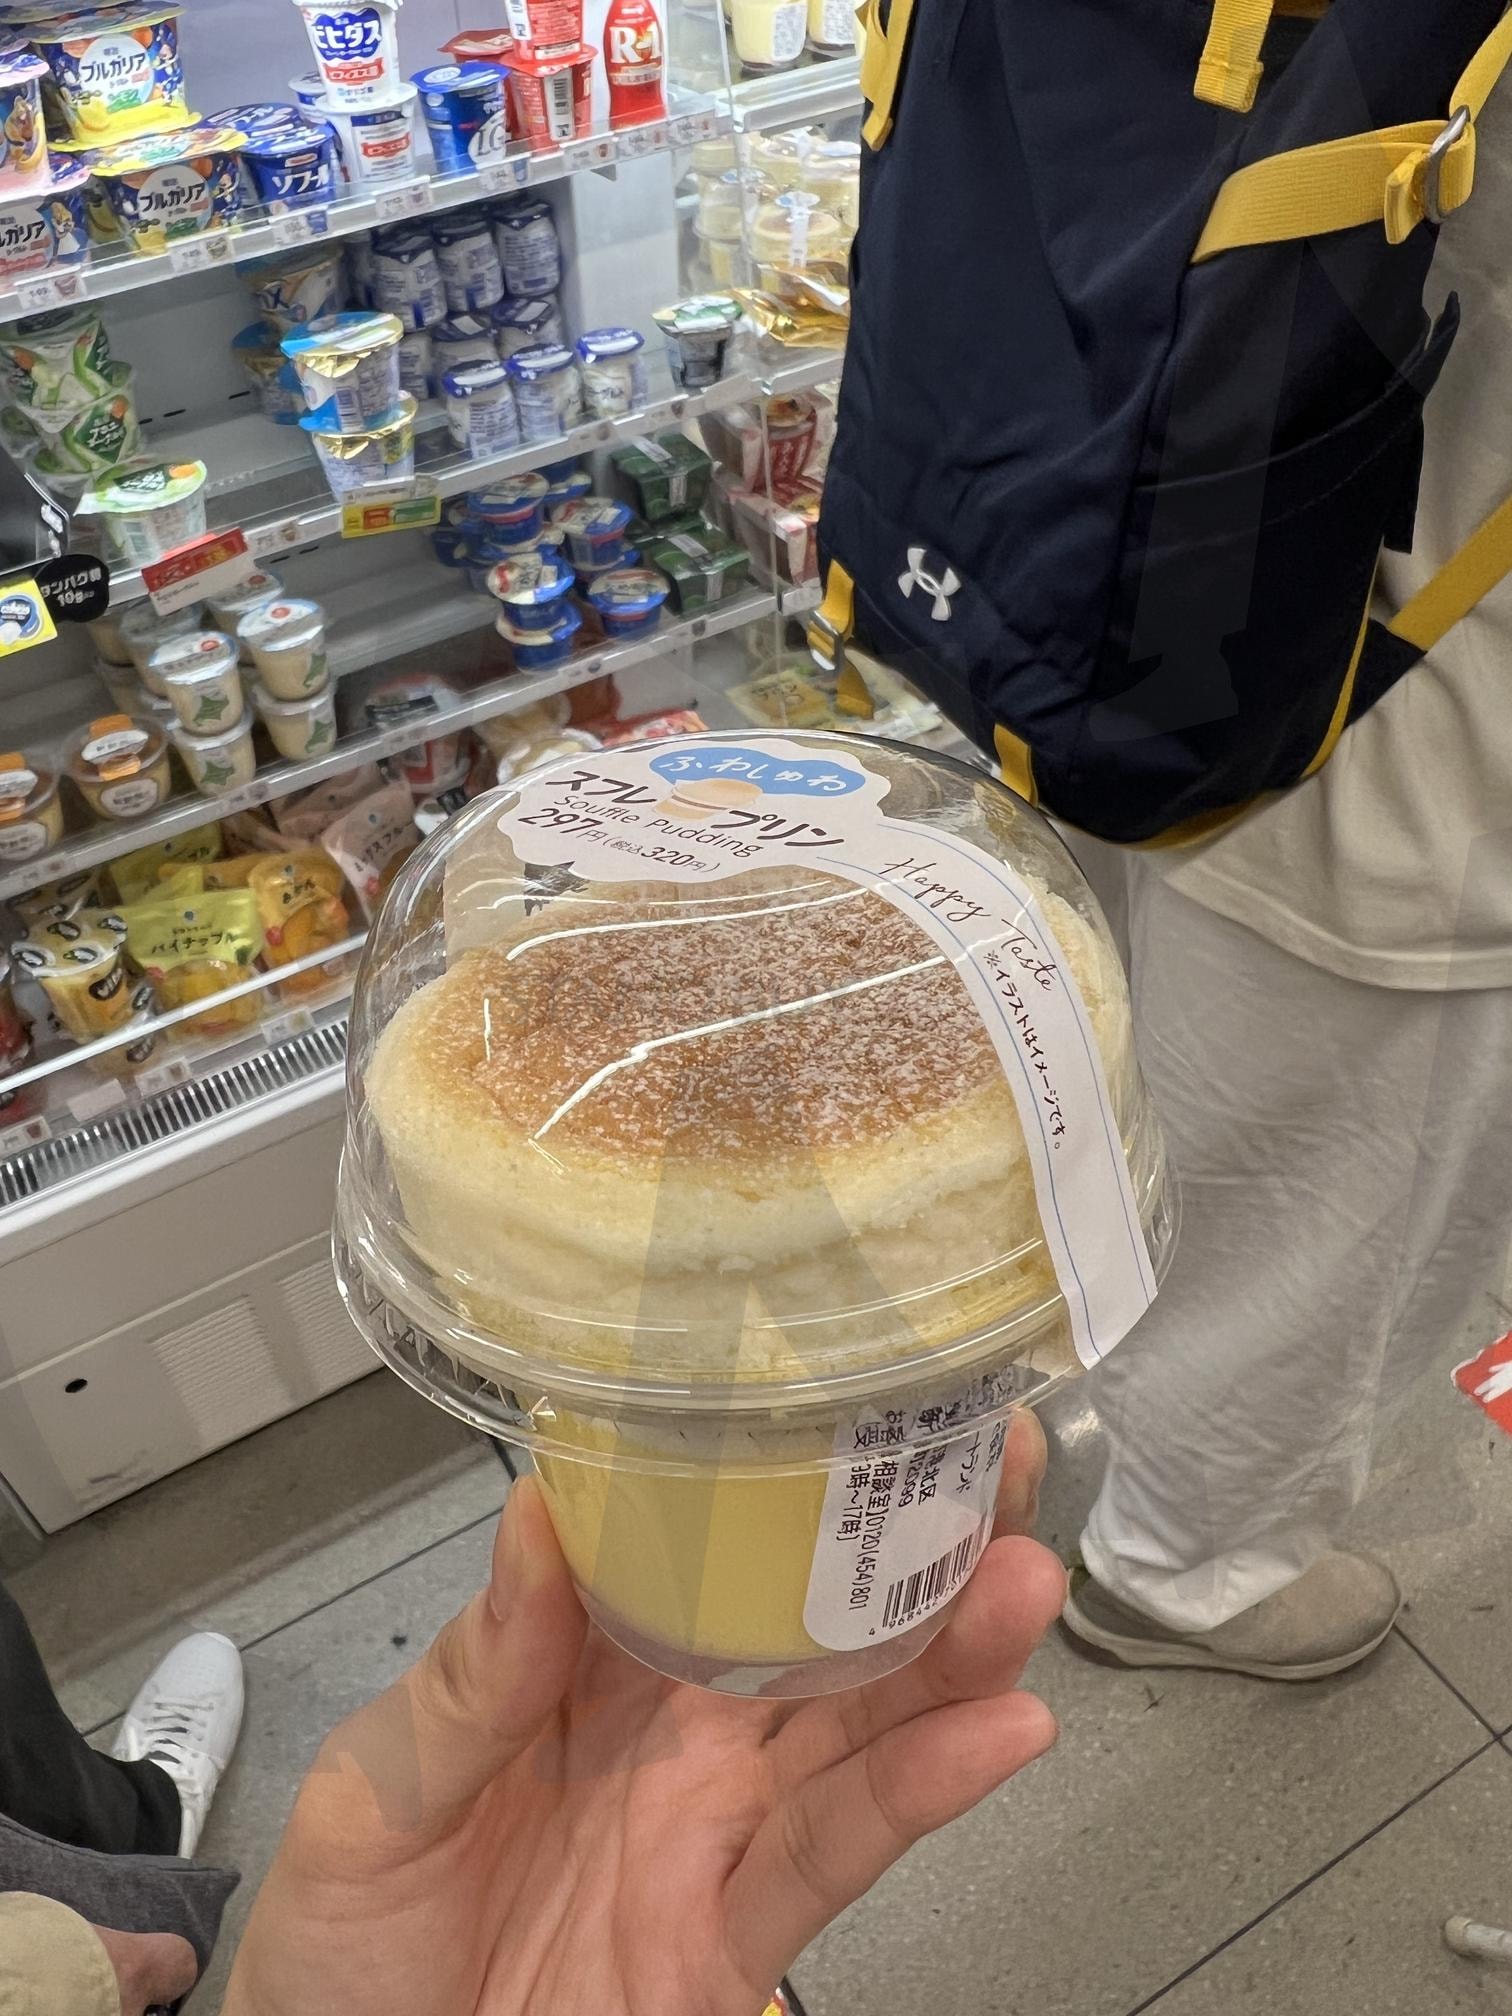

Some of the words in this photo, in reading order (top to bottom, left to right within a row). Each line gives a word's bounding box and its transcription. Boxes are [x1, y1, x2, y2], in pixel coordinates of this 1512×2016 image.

[609, 22, 662, 64] R-1
[81, 52, 146, 82] ブルガリア
[140, 182, 205, 212] ブルガリア
[659, 756, 847, 791] ふわしゅわ
[545, 770, 658, 804] スフレ
[710, 810, 845, 847] プリン
[878, 857, 992, 922] Happy
[1001, 918, 1057, 991] Taste
